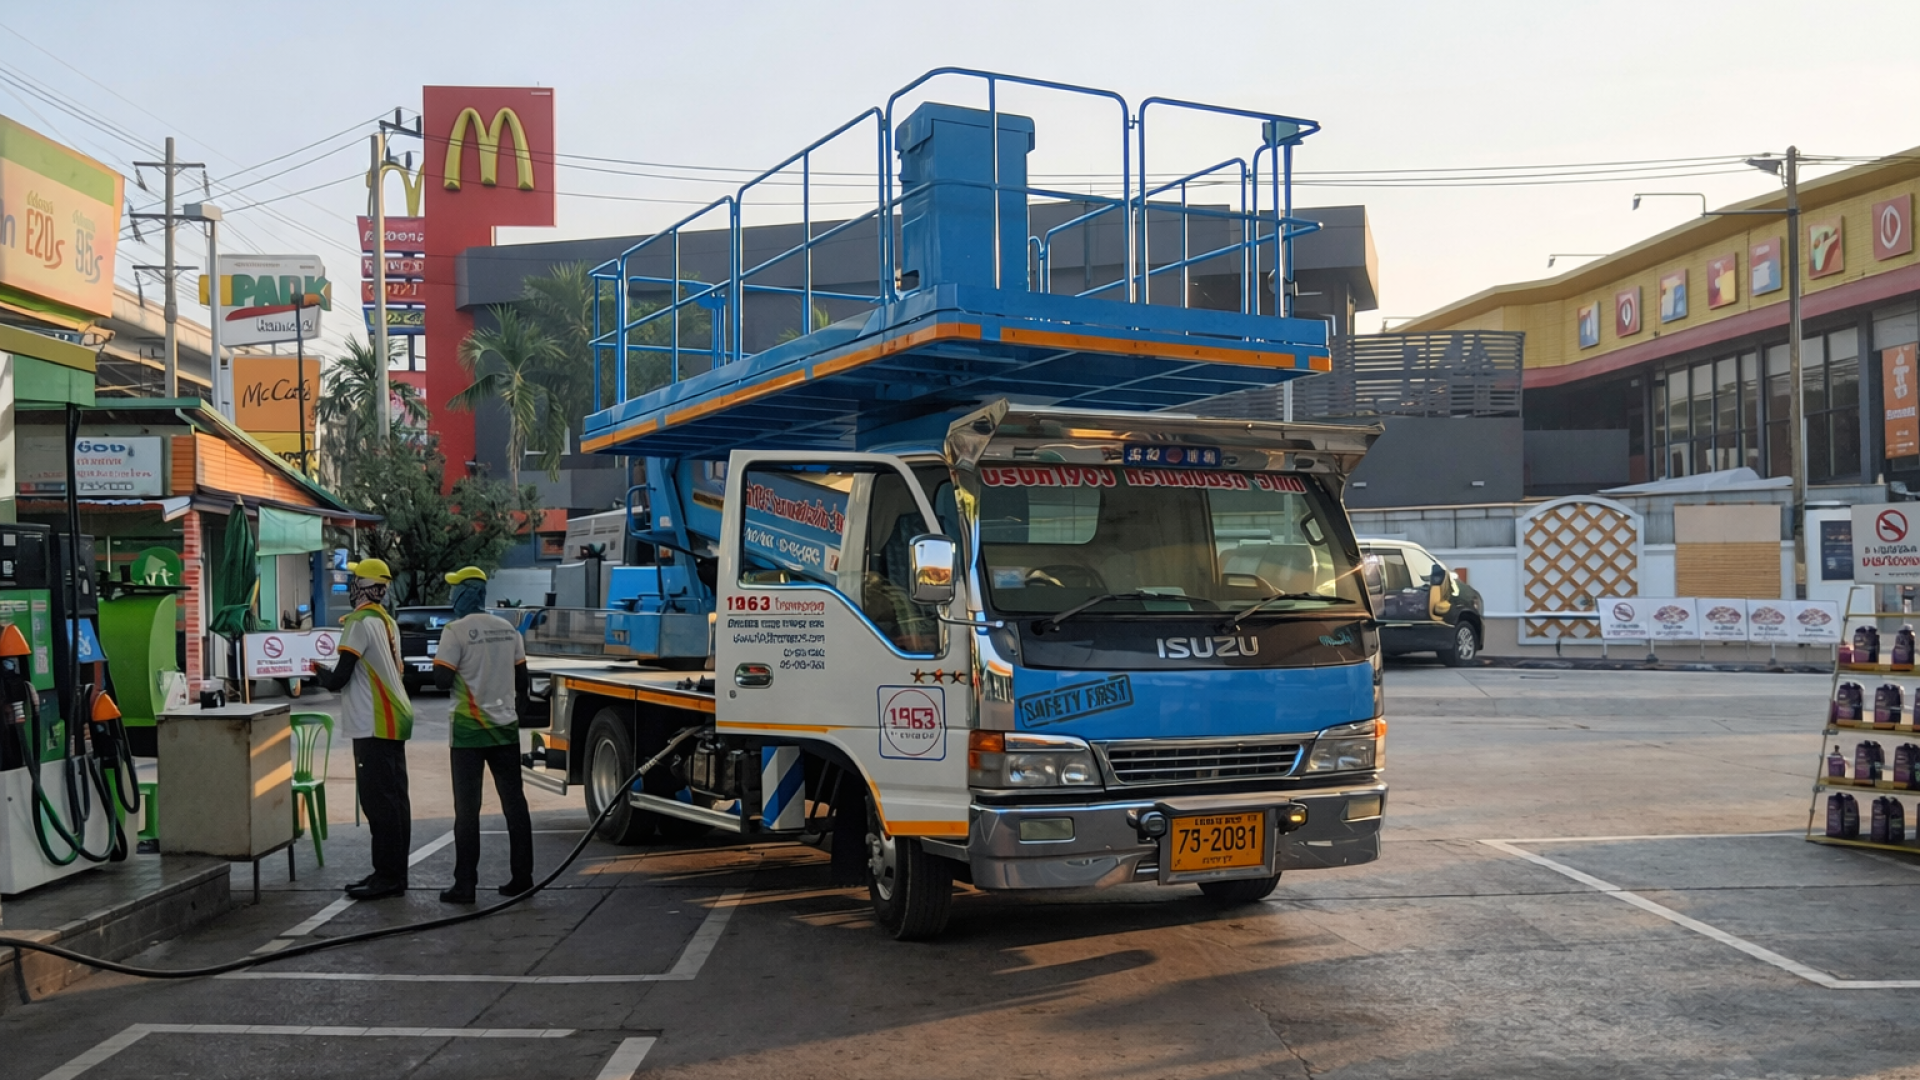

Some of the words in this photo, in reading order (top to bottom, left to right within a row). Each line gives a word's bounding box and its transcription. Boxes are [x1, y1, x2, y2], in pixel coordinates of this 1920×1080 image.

[1156, 635, 1260, 659] ISUZU
[890, 707, 935, 729] 1963
[1023, 690, 1081, 722] SAFETY
